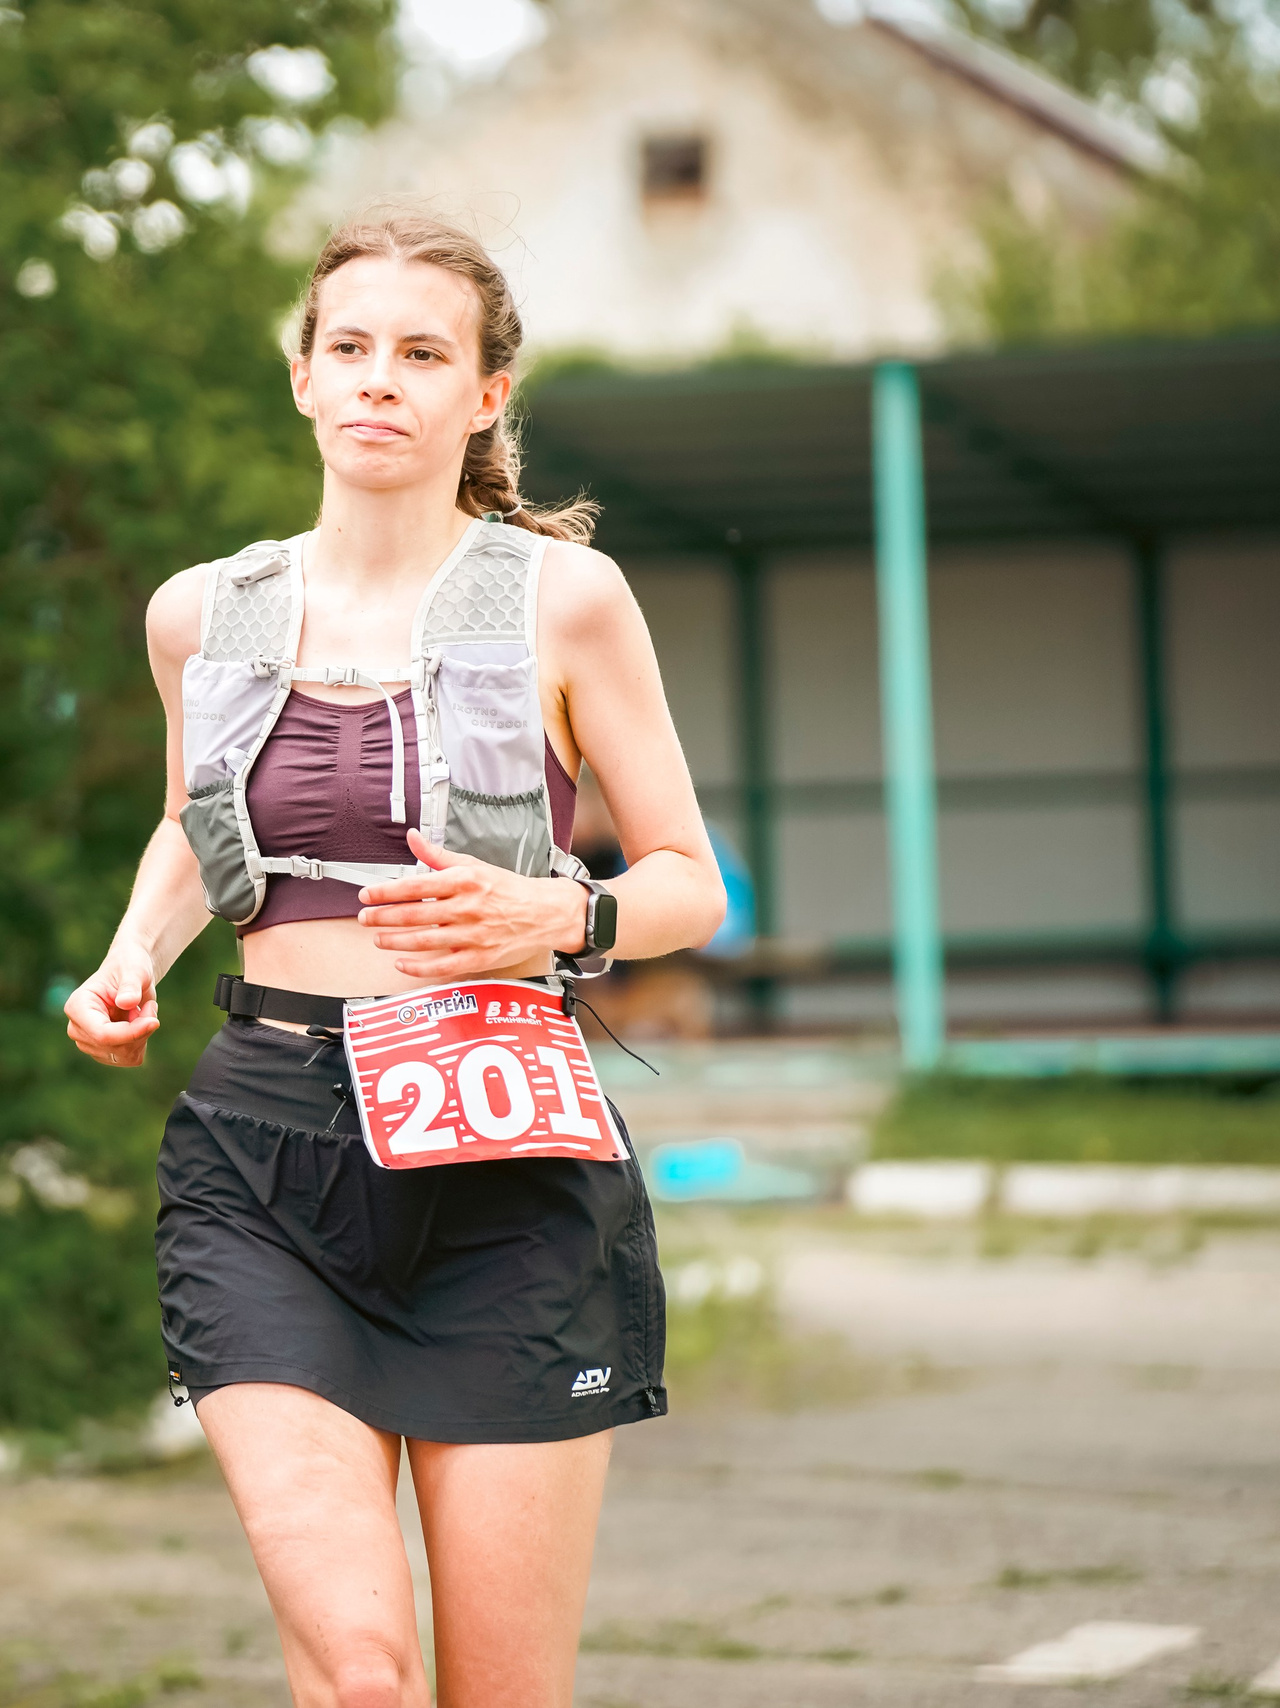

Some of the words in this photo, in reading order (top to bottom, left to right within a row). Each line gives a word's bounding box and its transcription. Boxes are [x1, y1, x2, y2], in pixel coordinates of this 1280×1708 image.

[452, 703, 498, 717] IXOTNO
[471, 719, 528, 729] OUTDOOR
[377, 1044, 602, 1155] 201
